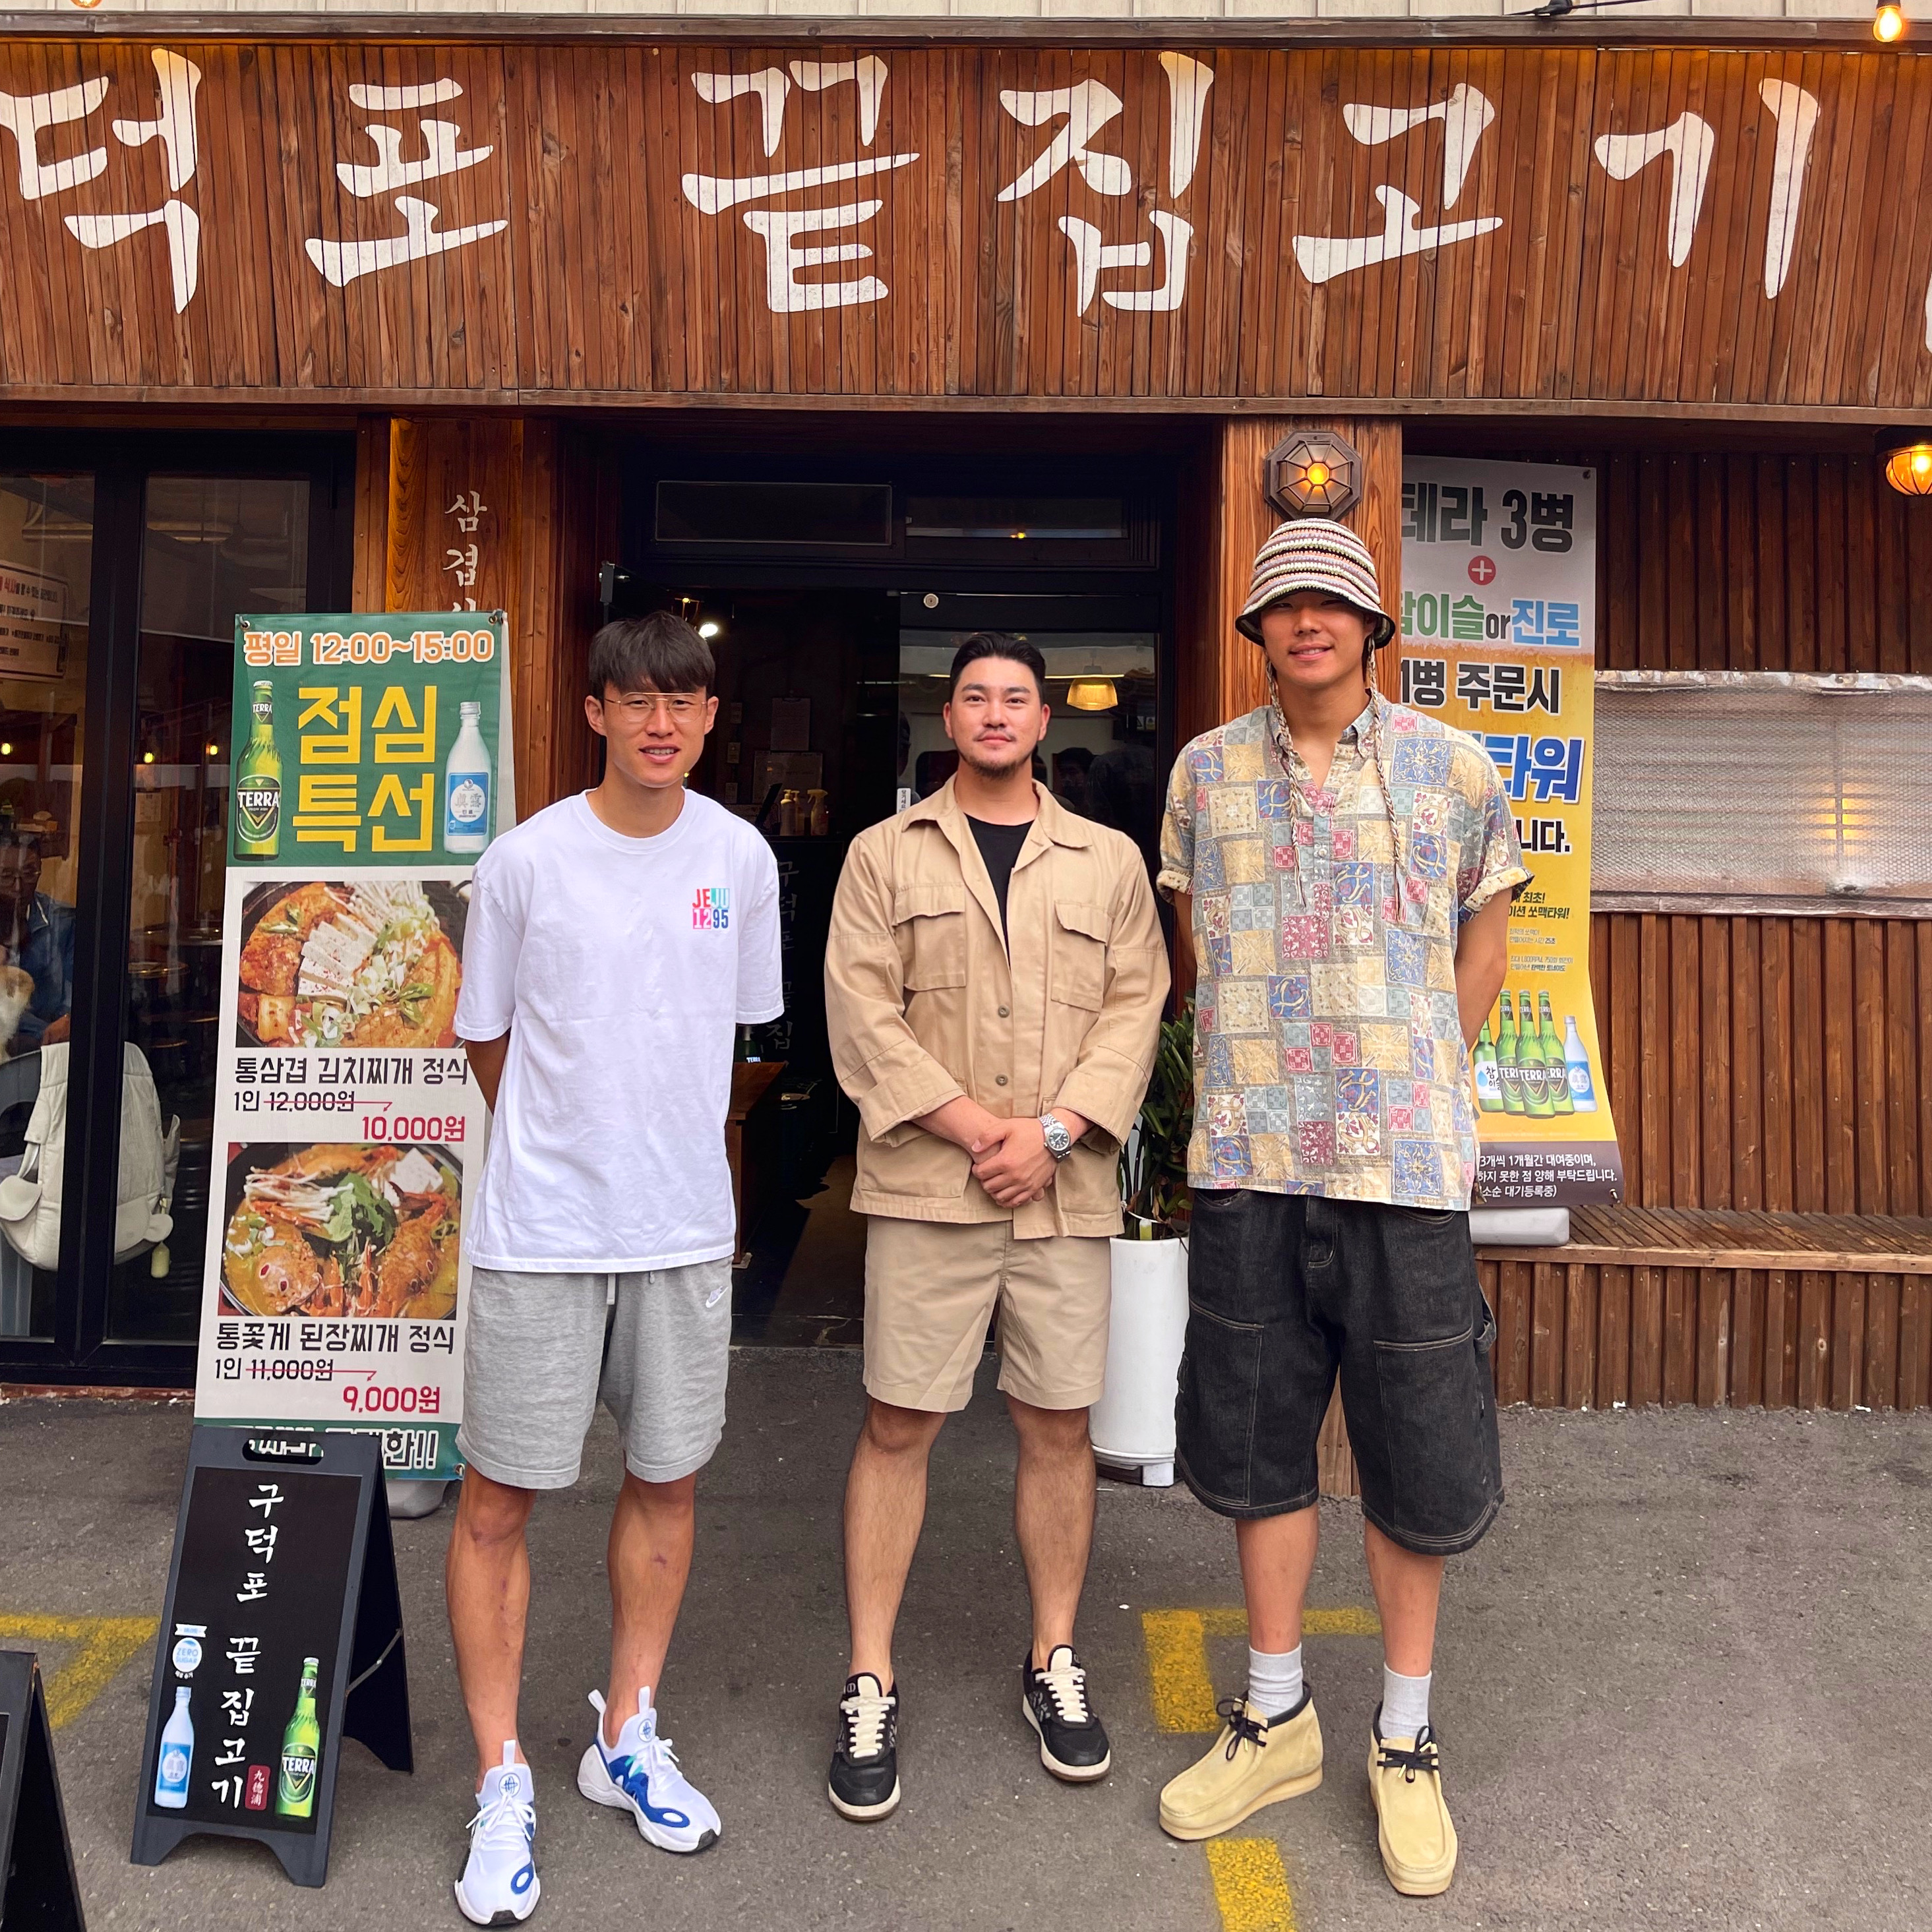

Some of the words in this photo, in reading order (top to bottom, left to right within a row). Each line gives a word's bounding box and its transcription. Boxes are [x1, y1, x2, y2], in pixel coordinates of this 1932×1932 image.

[0, 47, 508, 315] 덕포
[682, 51, 1821, 317] 끝집고기
[1402, 482, 1488, 547] 테라
[1501, 489, 1574, 553] 3병
[244, 631, 301, 666] 평일
[311, 630, 494, 665] 12:00~15:00
[1457, 663, 1559, 713] 주문시
[253, 703, 272, 713] TERRA
[297, 685, 437, 765] 점심
[1472, 732, 1583, 801] 타워
[238, 791, 280, 808] TERRA
[292, 773, 434, 853] 특선
[1516, 820, 1570, 853] 니다.
[692, 888, 729, 909] JEJU
[1523, 891, 1546, 903] 최초!
[235, 1057, 307, 1085] 통삼겹
[318, 1056, 413, 1085] 김치찌개
[423, 1058, 468, 1086] 정식
[1486, 1066, 1496, 1079] 참
[1519, 1070, 1546, 1081] TERRA
[1547, 1068, 1565, 1078] ERRA
[234, 1091, 260, 1112] 1인
[269, 1091, 355, 1112] 12,000원
[362, 1116, 466, 1142] 10,000원
[1509, 1155, 1543, 1167] 1개월간
[1546, 1153, 1596, 1167] 대여중이며,
[1499, 1170, 1519, 1182] 못한
[1522, 1171, 1532, 1182] 점
[1534, 1170, 1554, 1182] 양해
[1556, 1169, 1617, 1182] 부탁드립니다.
[1479, 1186, 1502, 1197] 소순
[1504, 1186, 1557, 1197] 대기등록중)
[216, 1323, 289, 1351] 통꽃게
[300, 1323, 398, 1353] 된장찌개
[409, 1325, 455, 1354] 정식
[215, 1358, 242, 1381] 1인
[251, 1358, 334, 1382] 11,000원
[343, 1386, 440, 1414] 9,000원
[236, 1483, 284, 1603] 구덕포
[177, 1648, 198, 1657] ZERO
[212, 1636, 261, 1809] 끝집고기
[283, 1757, 315, 1774] TERRA
